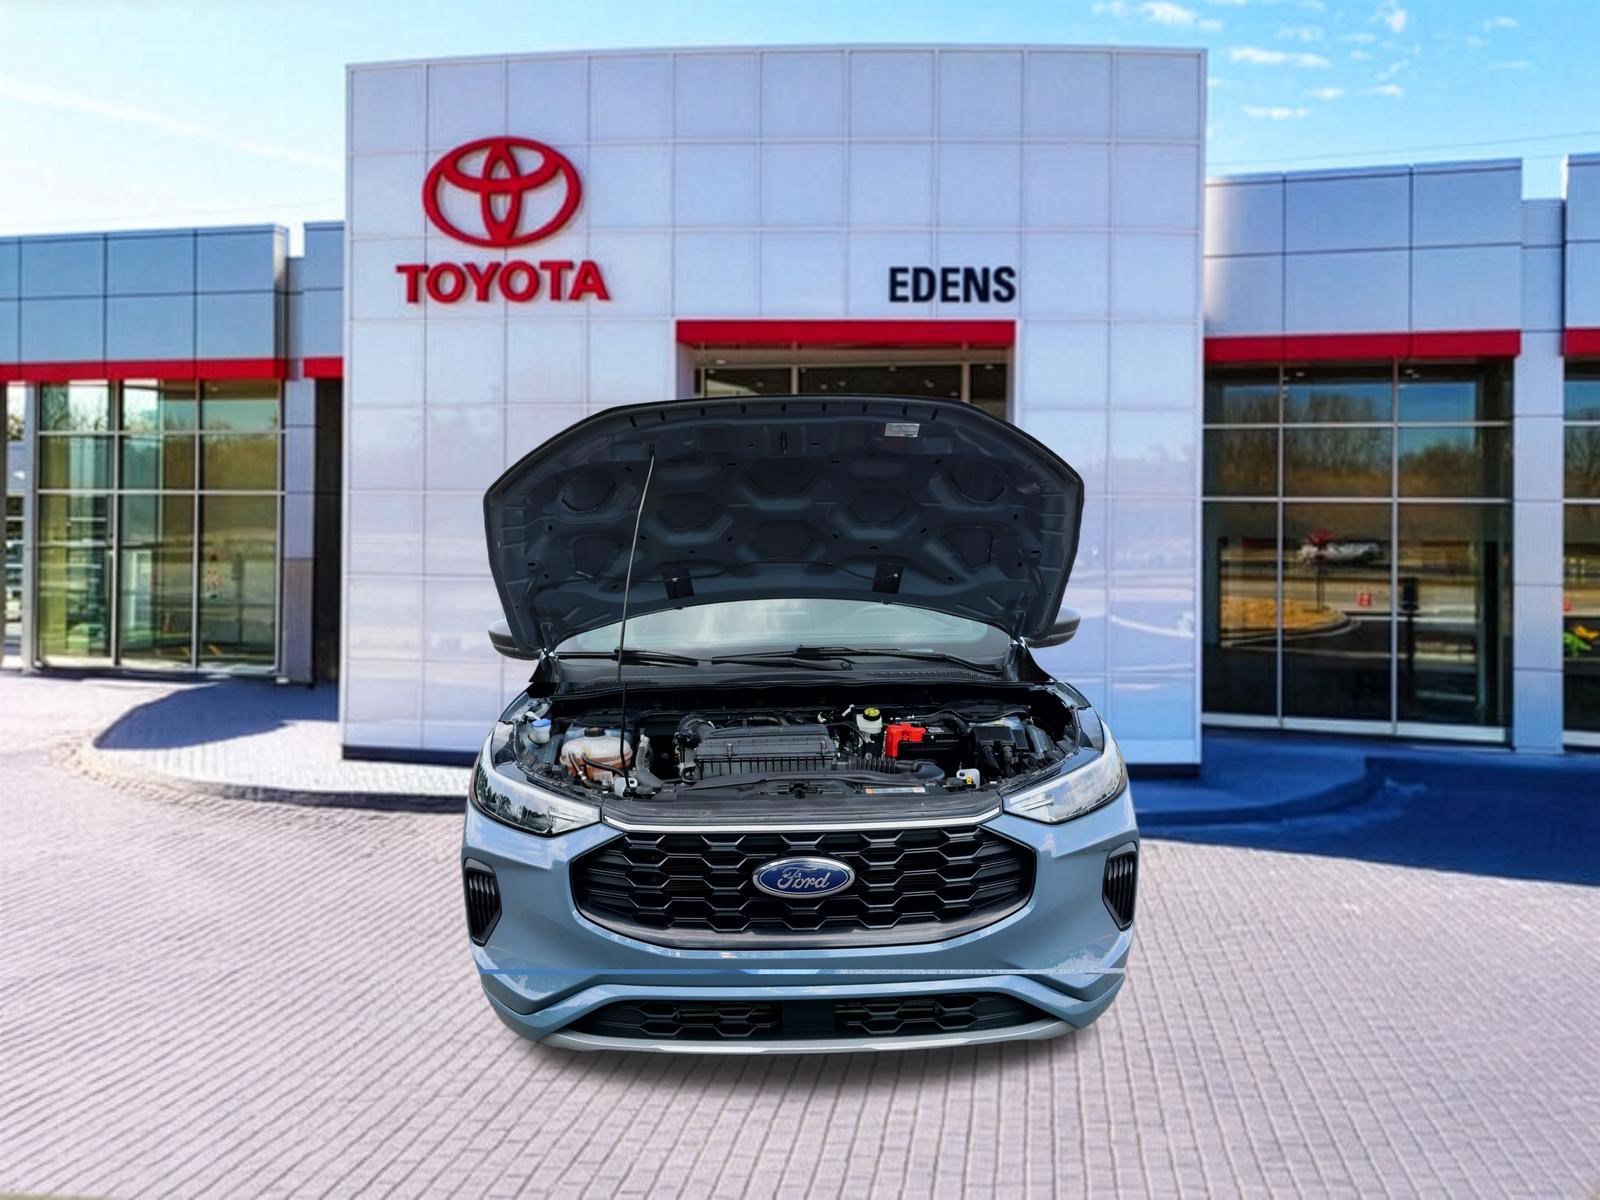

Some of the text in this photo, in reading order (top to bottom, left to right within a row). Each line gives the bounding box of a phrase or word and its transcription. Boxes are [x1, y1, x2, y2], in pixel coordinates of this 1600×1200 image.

[395, 259, 610, 304] TOYOTA
[889, 266, 1016, 303] EDENS
[777, 866, 831, 889] Ford
